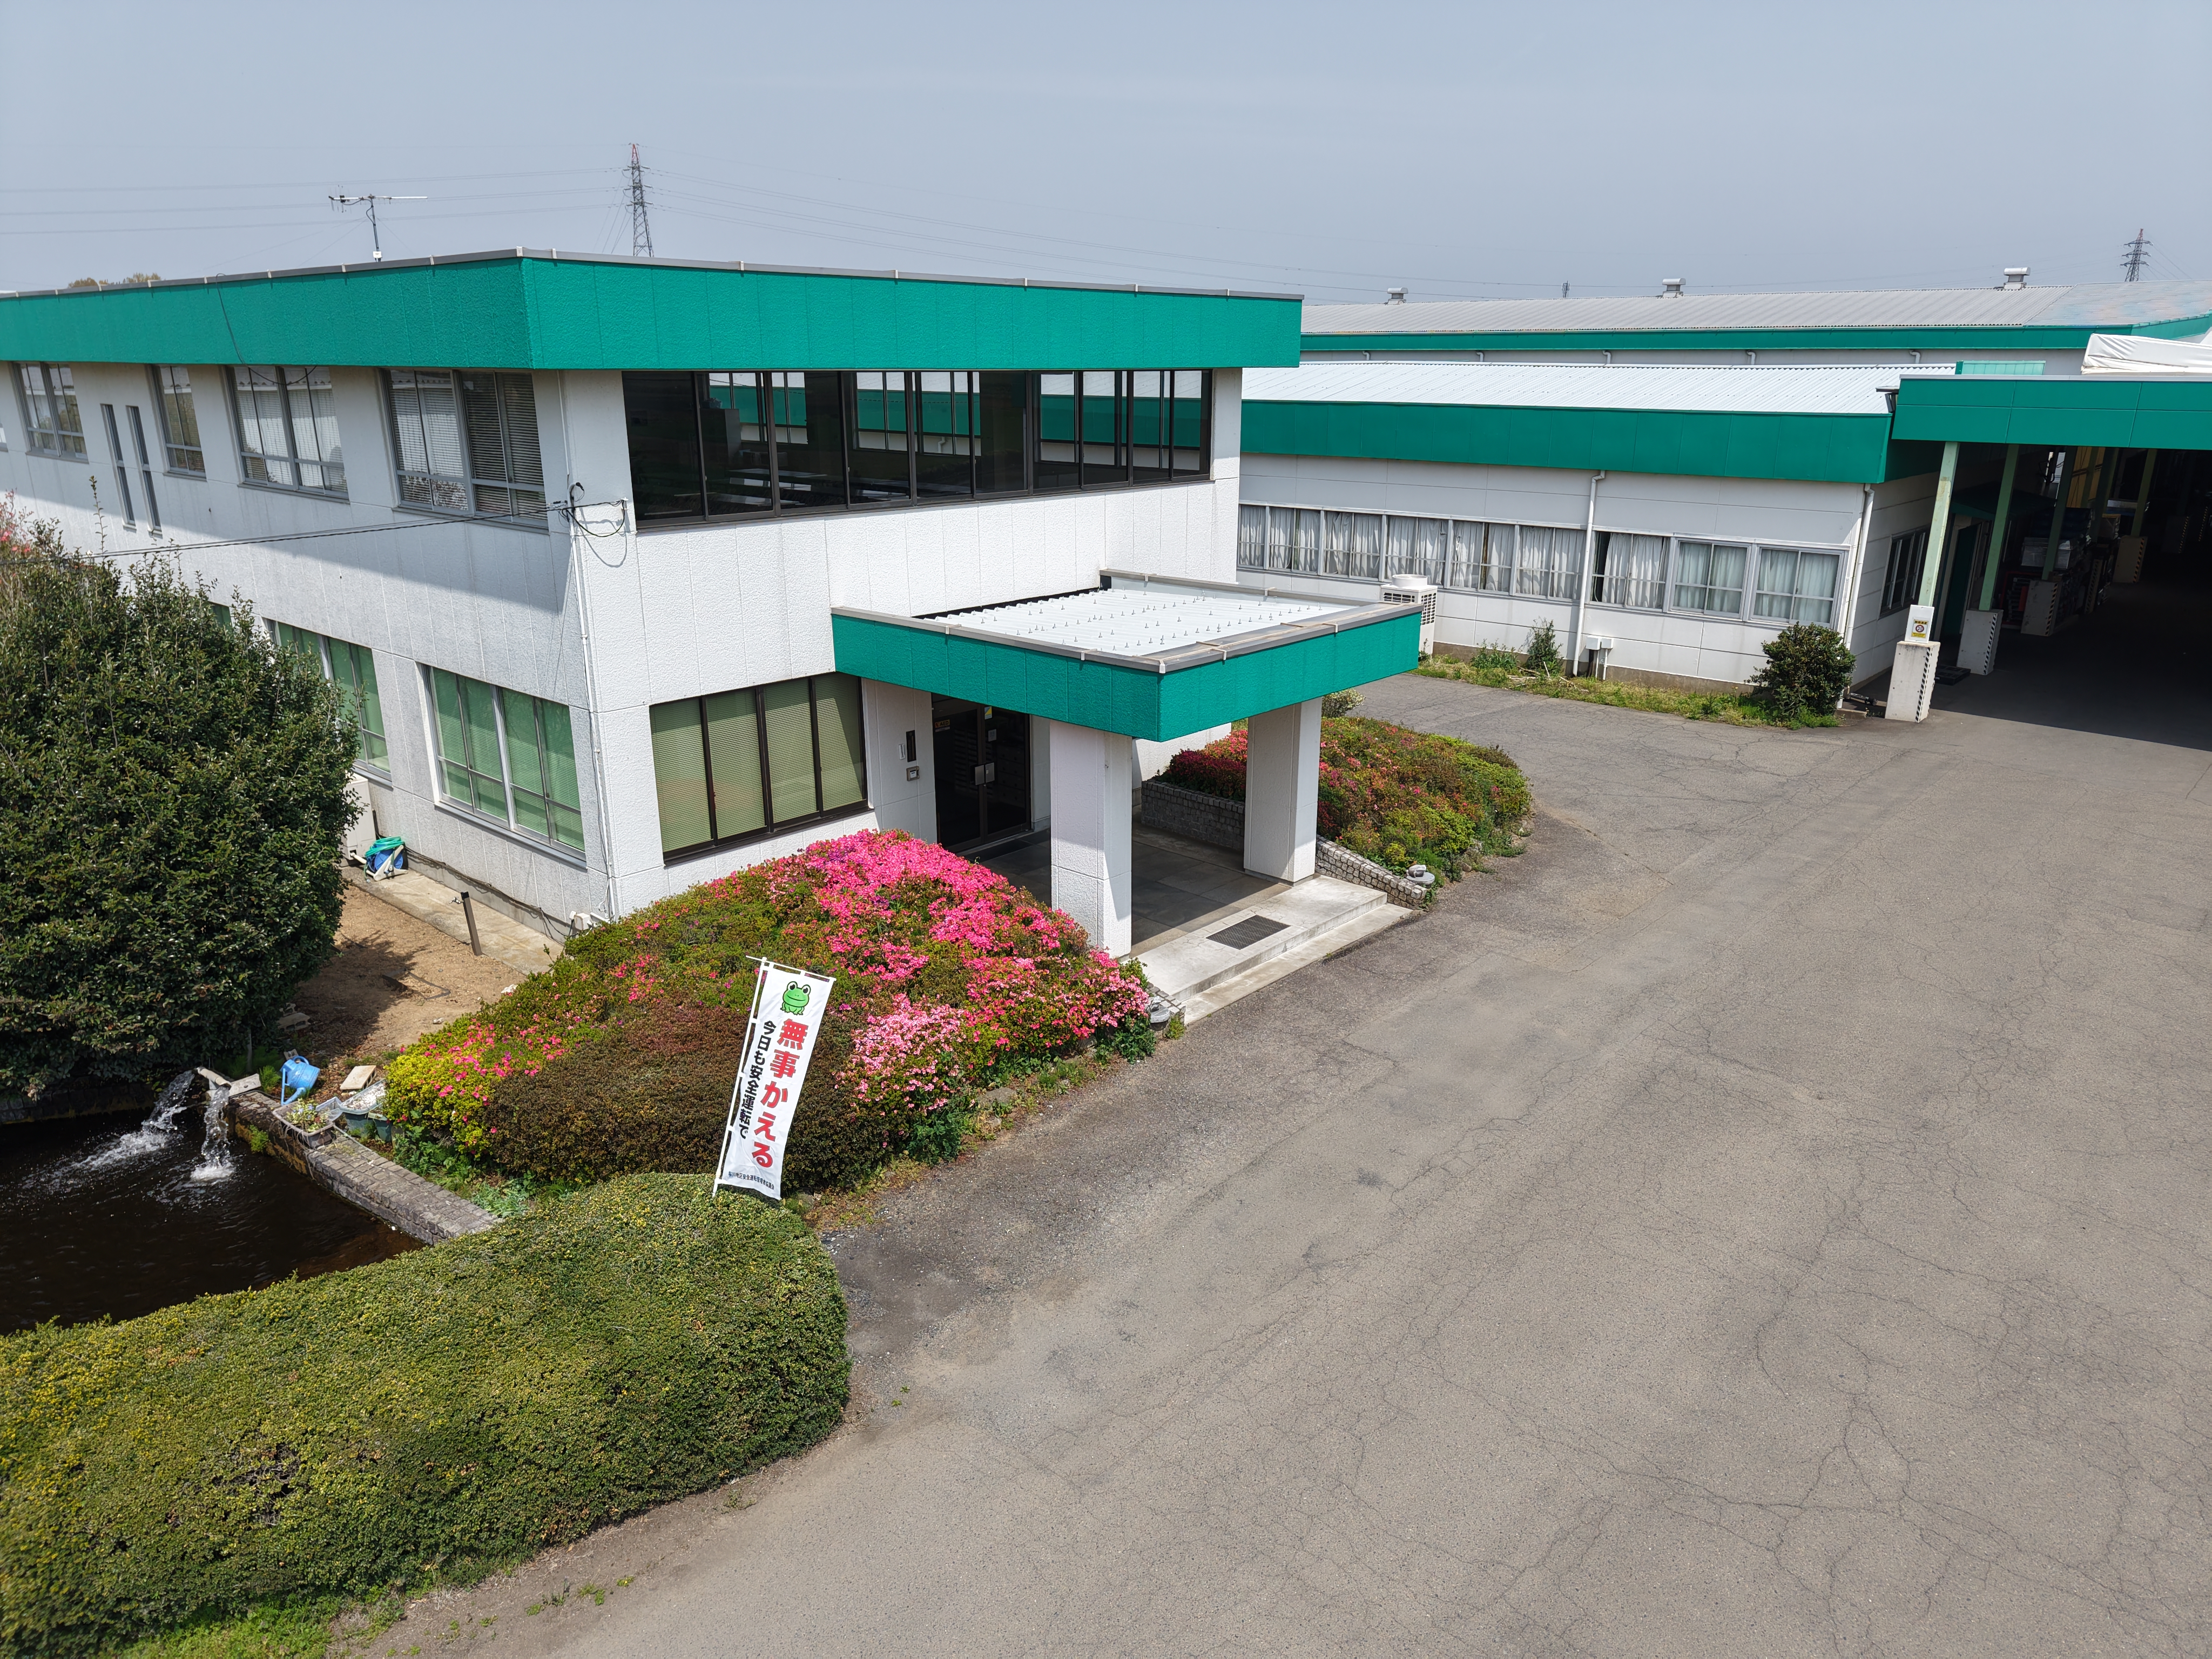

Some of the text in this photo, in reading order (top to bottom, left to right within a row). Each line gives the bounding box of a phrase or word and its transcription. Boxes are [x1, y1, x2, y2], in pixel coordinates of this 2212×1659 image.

[739, 1020, 777, 1139] 今日も安全運転で
[752, 1018, 808, 1168] 無事かえる
